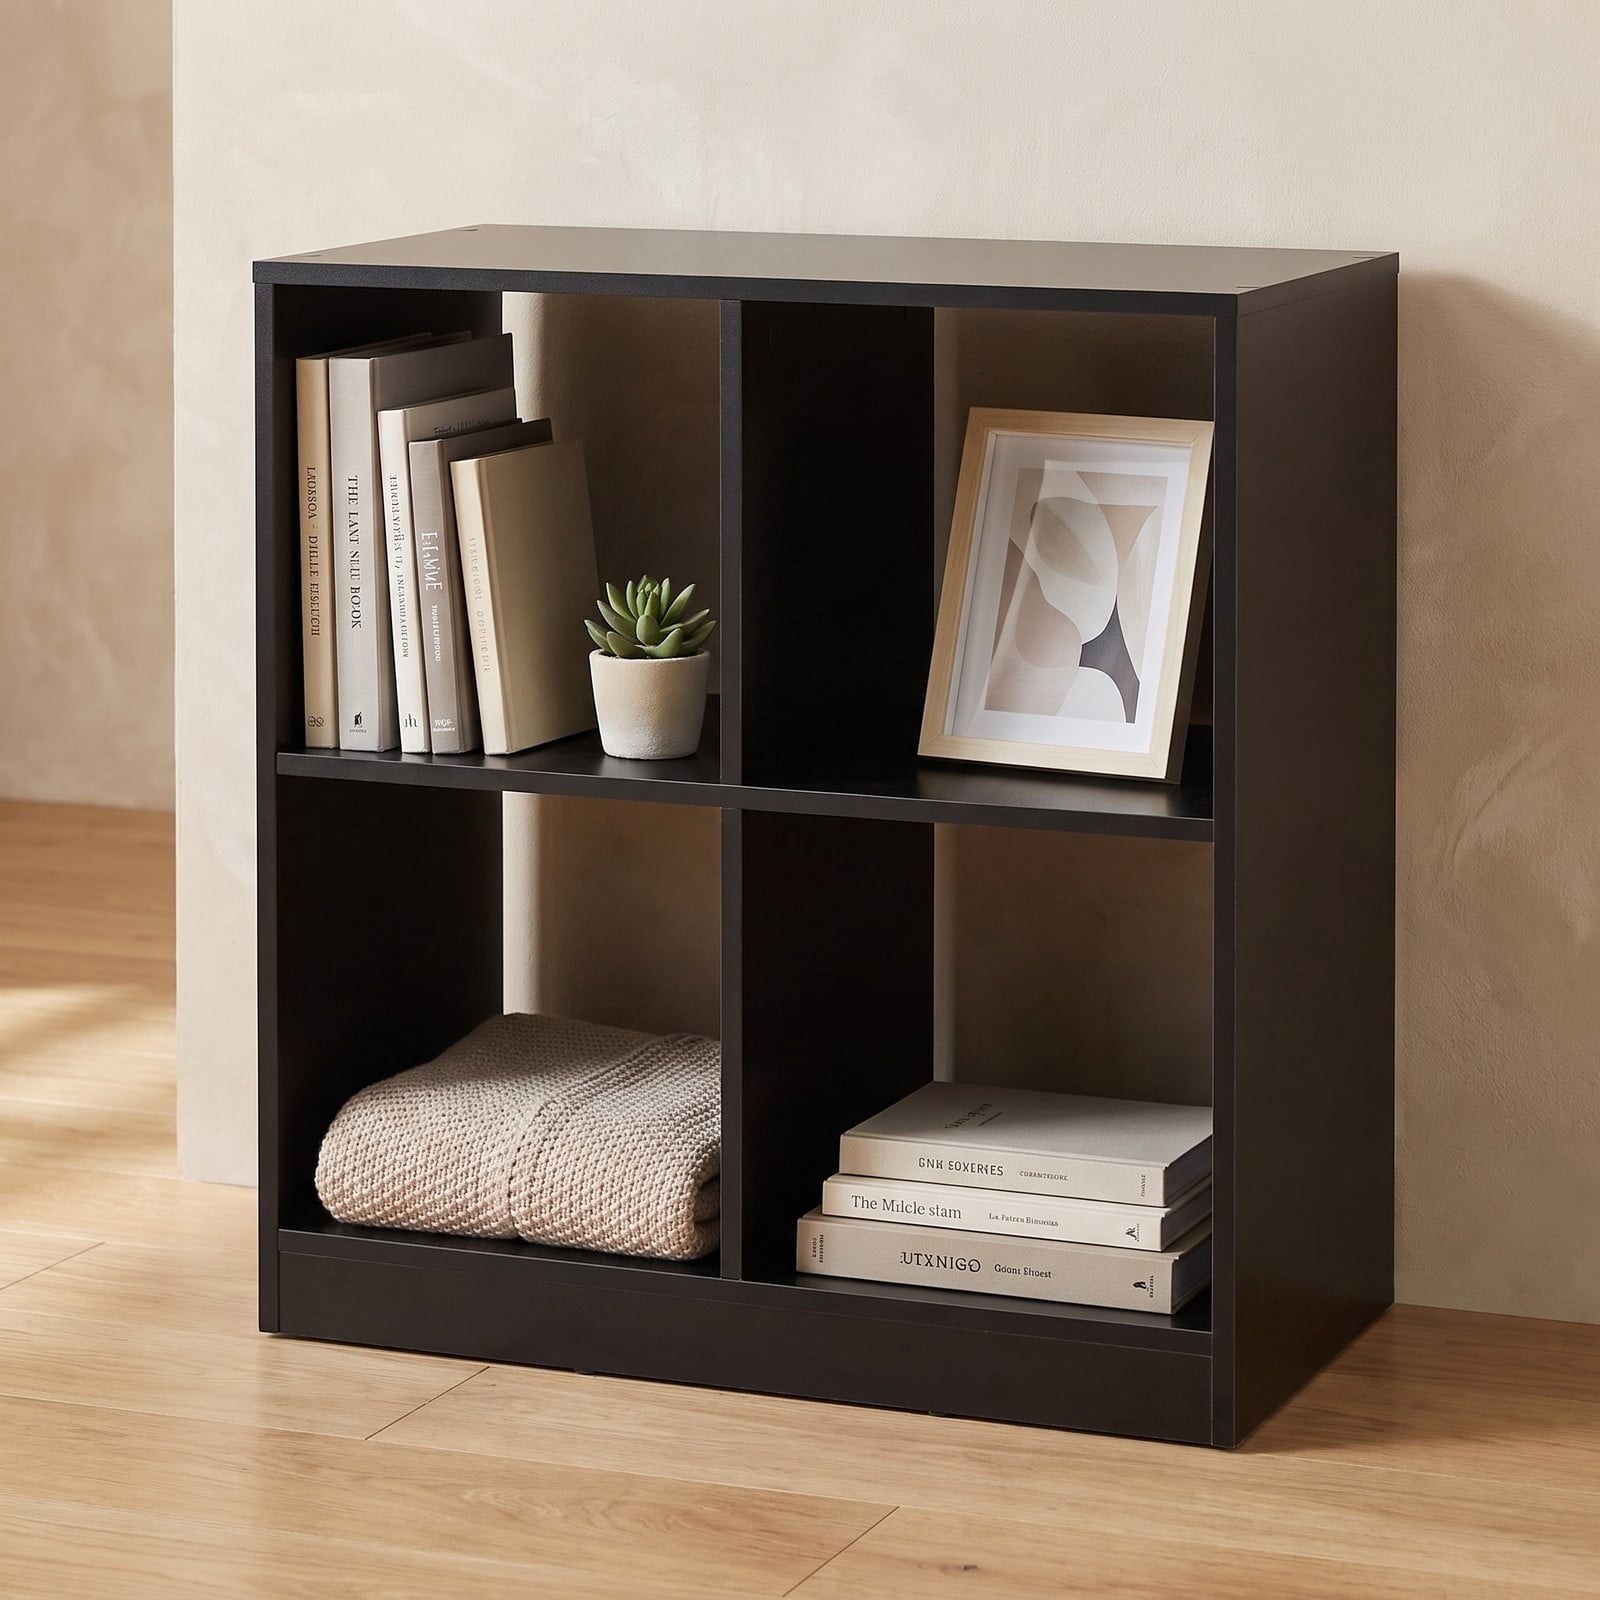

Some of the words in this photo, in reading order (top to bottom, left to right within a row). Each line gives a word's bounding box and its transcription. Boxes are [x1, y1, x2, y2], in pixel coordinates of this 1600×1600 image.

[348, 475, 359, 505] THE
[851, 1195, 878, 1210] The
[928, 1203, 962, 1219] stam
